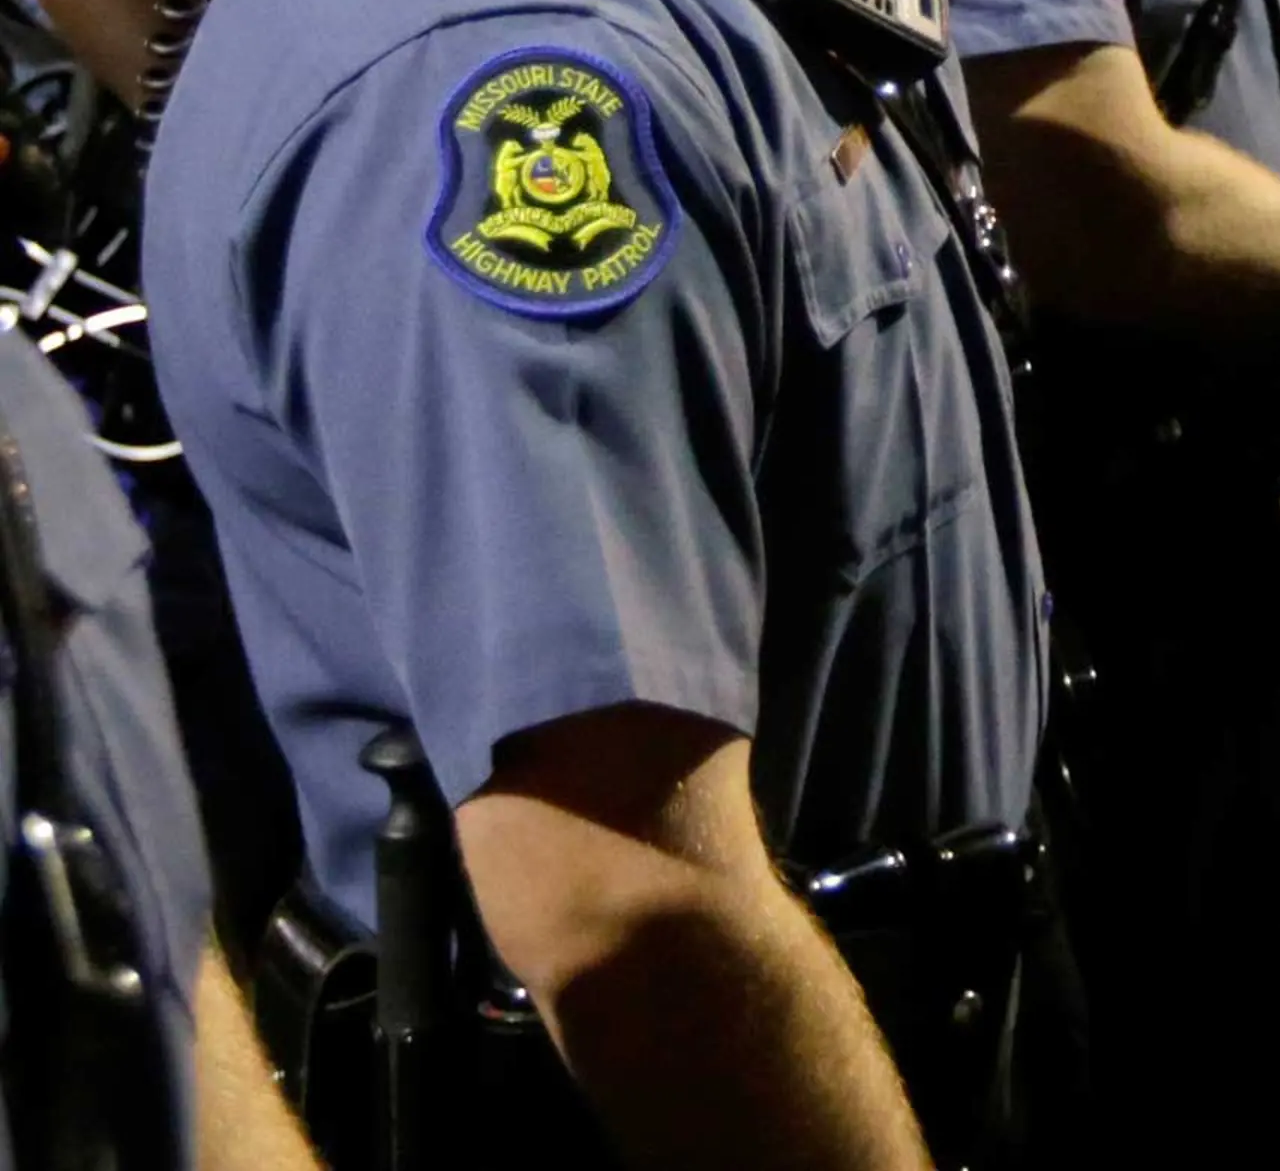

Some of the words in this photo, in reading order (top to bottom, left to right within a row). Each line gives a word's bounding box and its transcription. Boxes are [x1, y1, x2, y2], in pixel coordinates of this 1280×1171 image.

[457, 65, 556, 132] MISSOURI
[560, 66, 623, 119] STATE
[452, 232, 571, 294] HIGHWAY
[581, 224, 663, 291] PATROL
